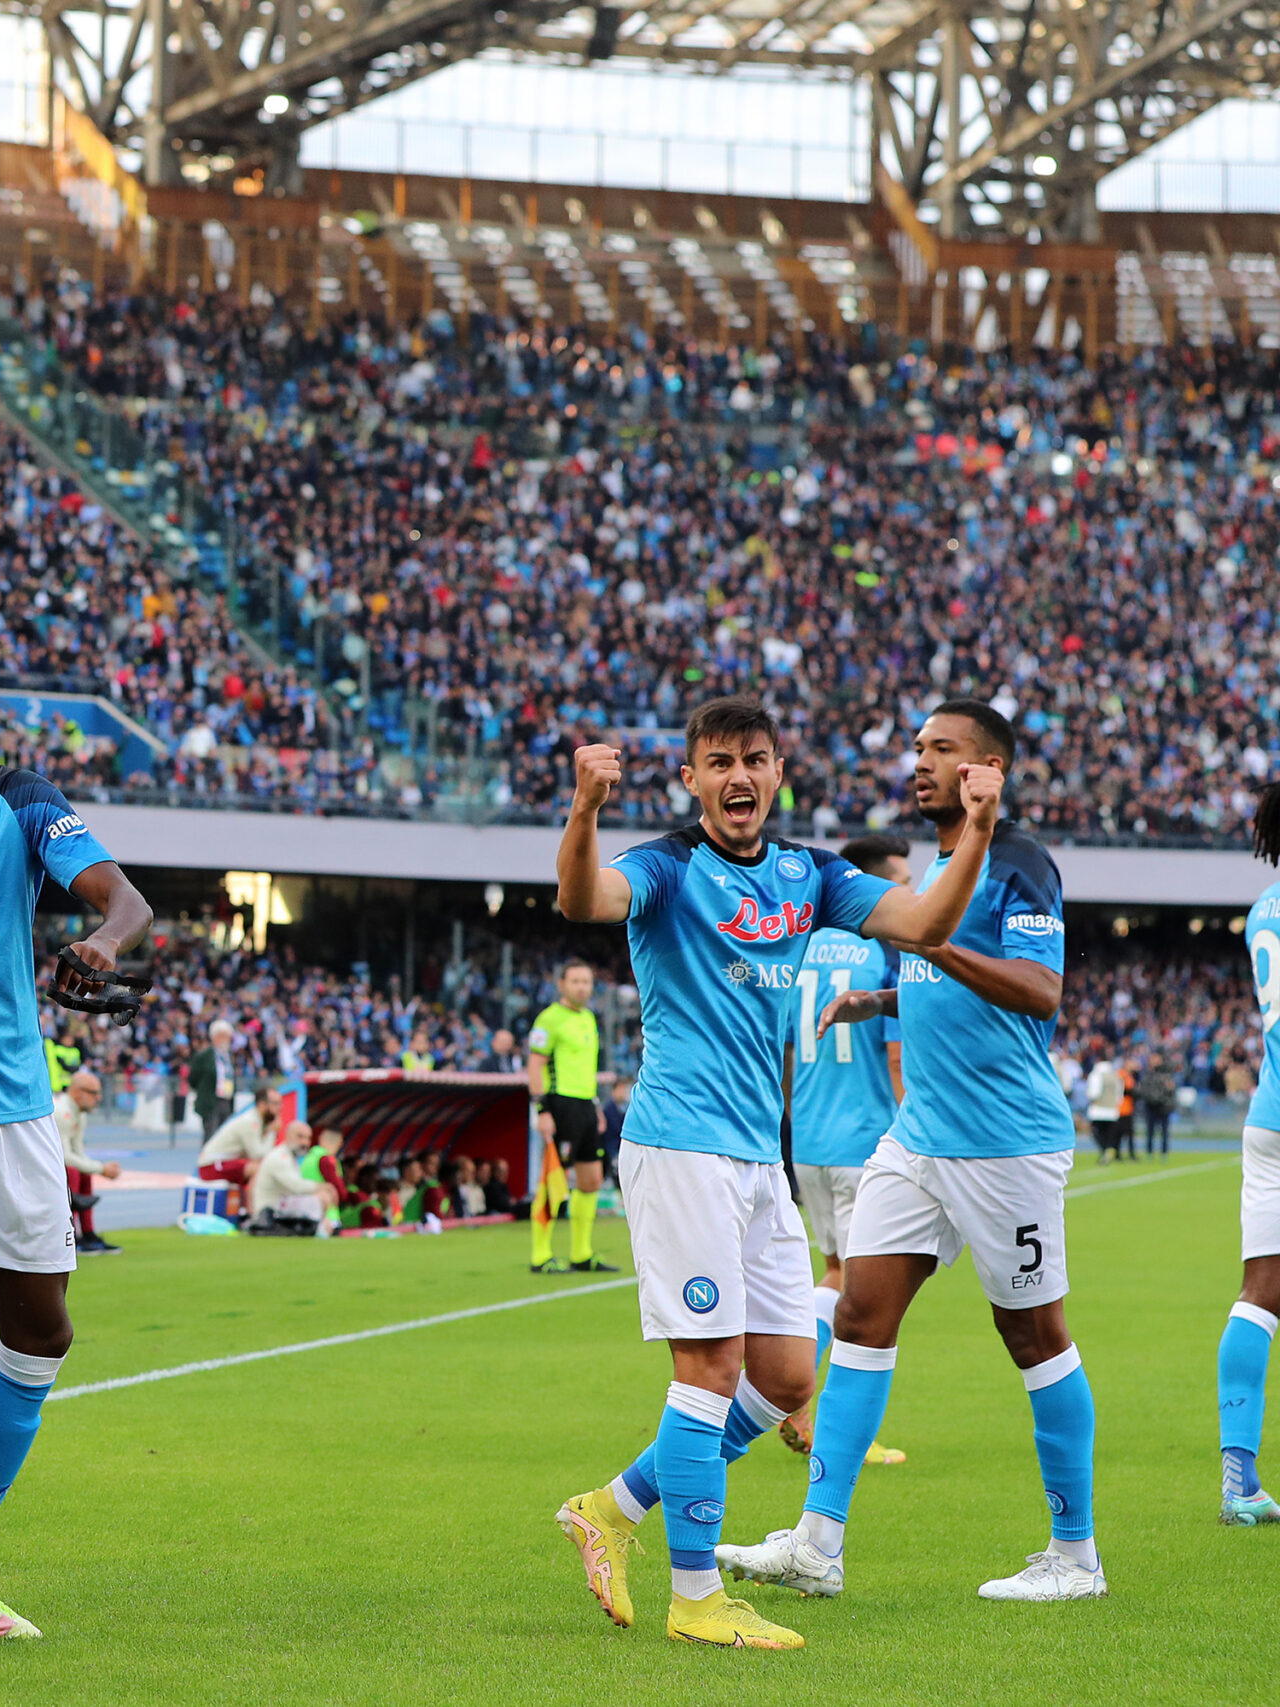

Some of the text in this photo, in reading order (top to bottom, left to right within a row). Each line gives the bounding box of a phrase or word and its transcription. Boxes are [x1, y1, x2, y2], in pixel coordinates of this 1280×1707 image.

[717, 897, 814, 942] Lete
[1256, 897, 1280, 921] AN
[755, 963, 794, 988] MS
[795, 969, 853, 1063] 11
[1016, 1223, 1042, 1273] 5
[1012, 1270, 1045, 1289] EA7
[692, 1286, 708, 1303] N
